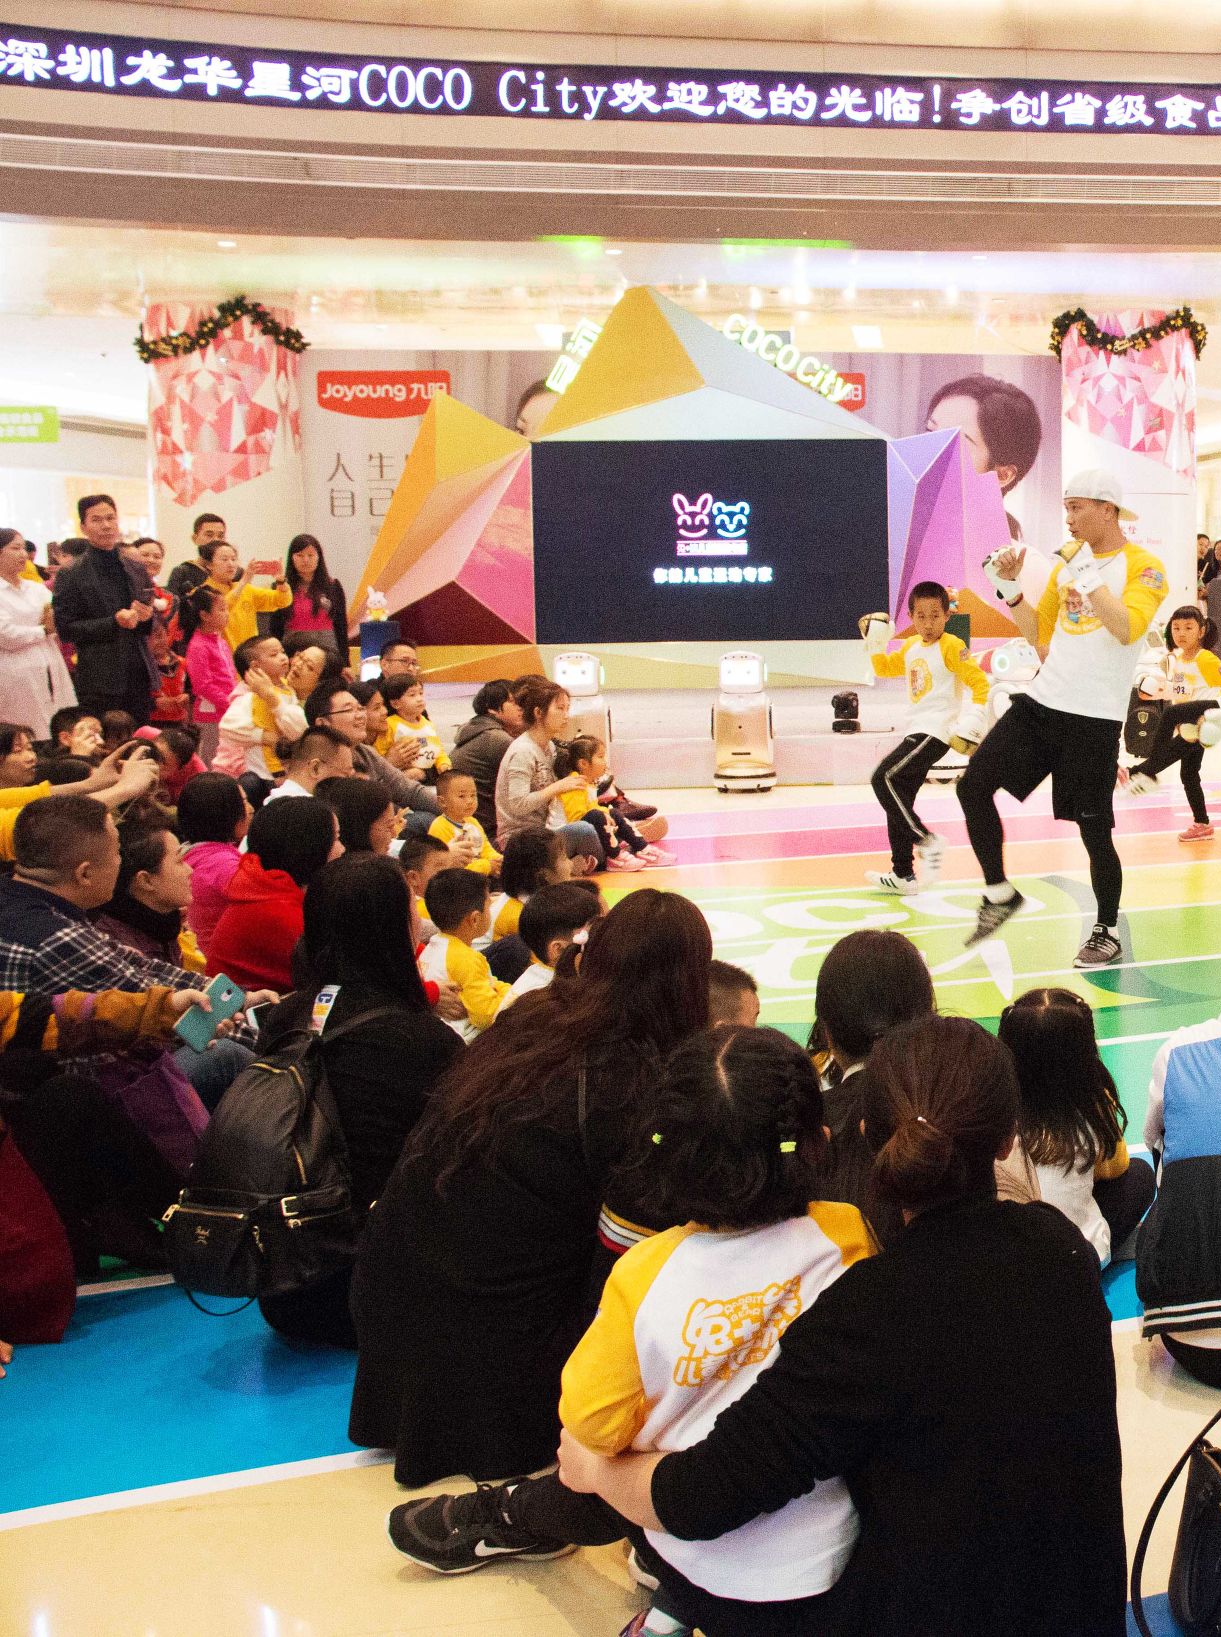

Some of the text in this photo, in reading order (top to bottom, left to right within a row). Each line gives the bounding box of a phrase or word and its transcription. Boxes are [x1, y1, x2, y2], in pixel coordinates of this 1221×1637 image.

[0, 38, 472, 111] 深圳龙华星河COCO
[722, 313, 852, 402] COCO City
[321, 383, 407, 402] Joyoung
[327, 452, 409, 482] 人生
[330, 488, 395, 518] 自己
